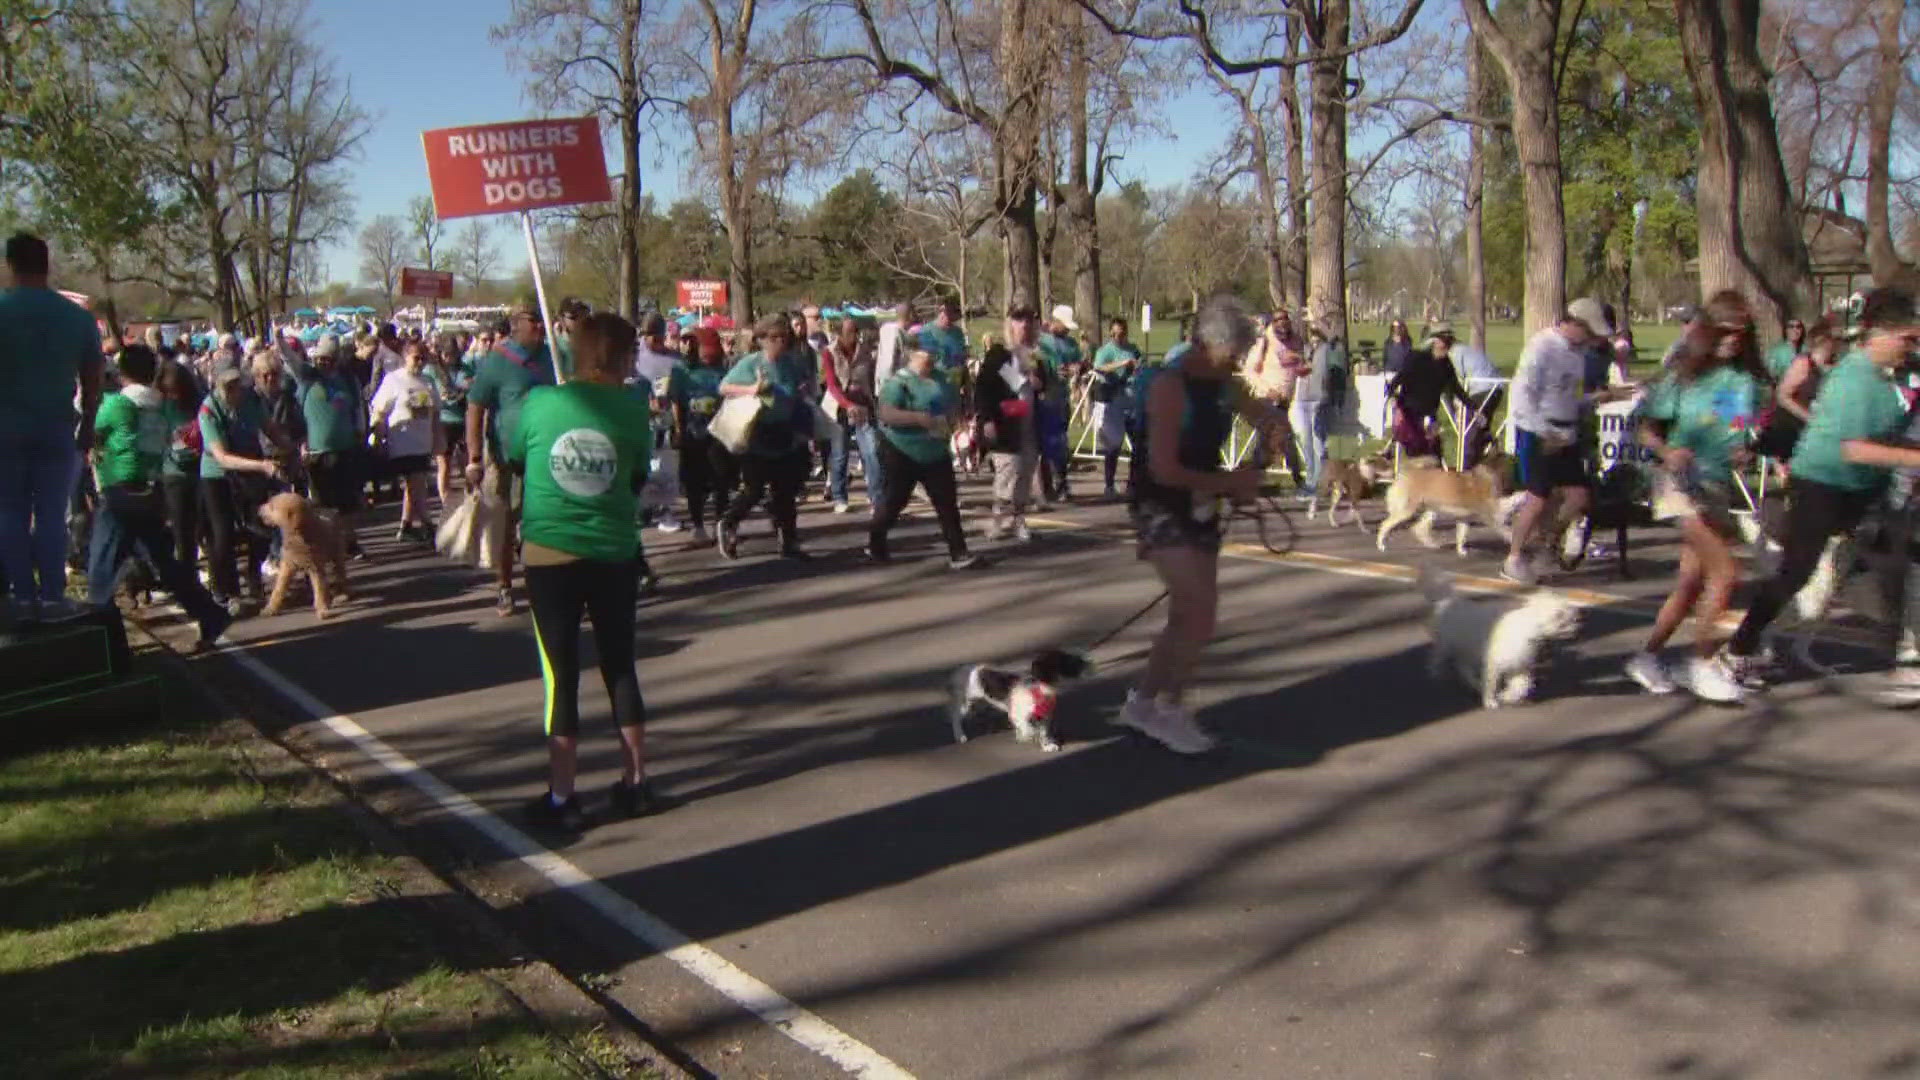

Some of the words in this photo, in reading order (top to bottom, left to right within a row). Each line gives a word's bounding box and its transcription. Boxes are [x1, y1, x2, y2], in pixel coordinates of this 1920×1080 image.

[448, 124, 579, 157] RUNNERS
[483, 152, 556, 177] WITH
[484, 177, 563, 205] DOGS
